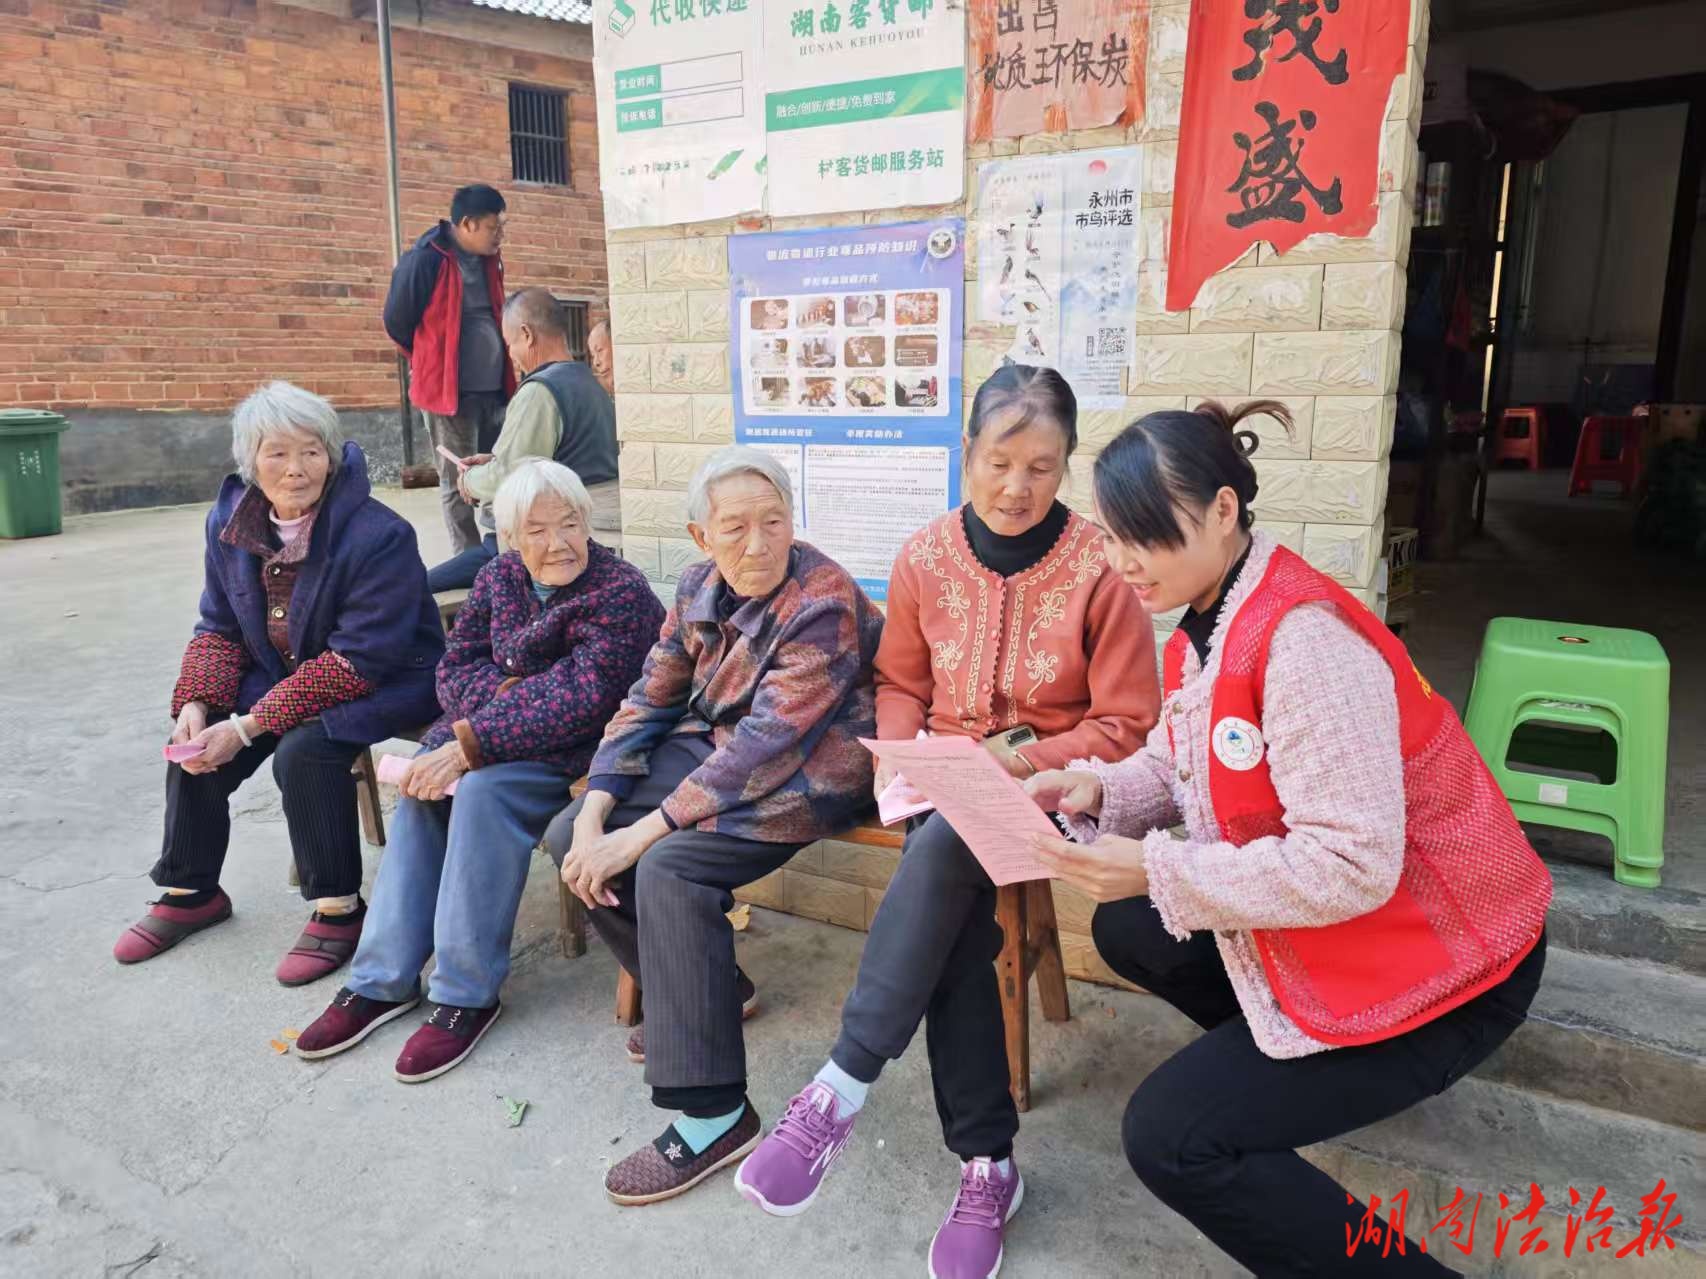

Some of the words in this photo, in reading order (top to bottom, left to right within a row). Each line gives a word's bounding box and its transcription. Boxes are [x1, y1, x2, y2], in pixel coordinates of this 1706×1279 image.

[799, 39, 844, 56] HUNAN
[1088, 188, 1134, 209] 永州市
[1075, 209, 1134, 229] 市鸟评选
